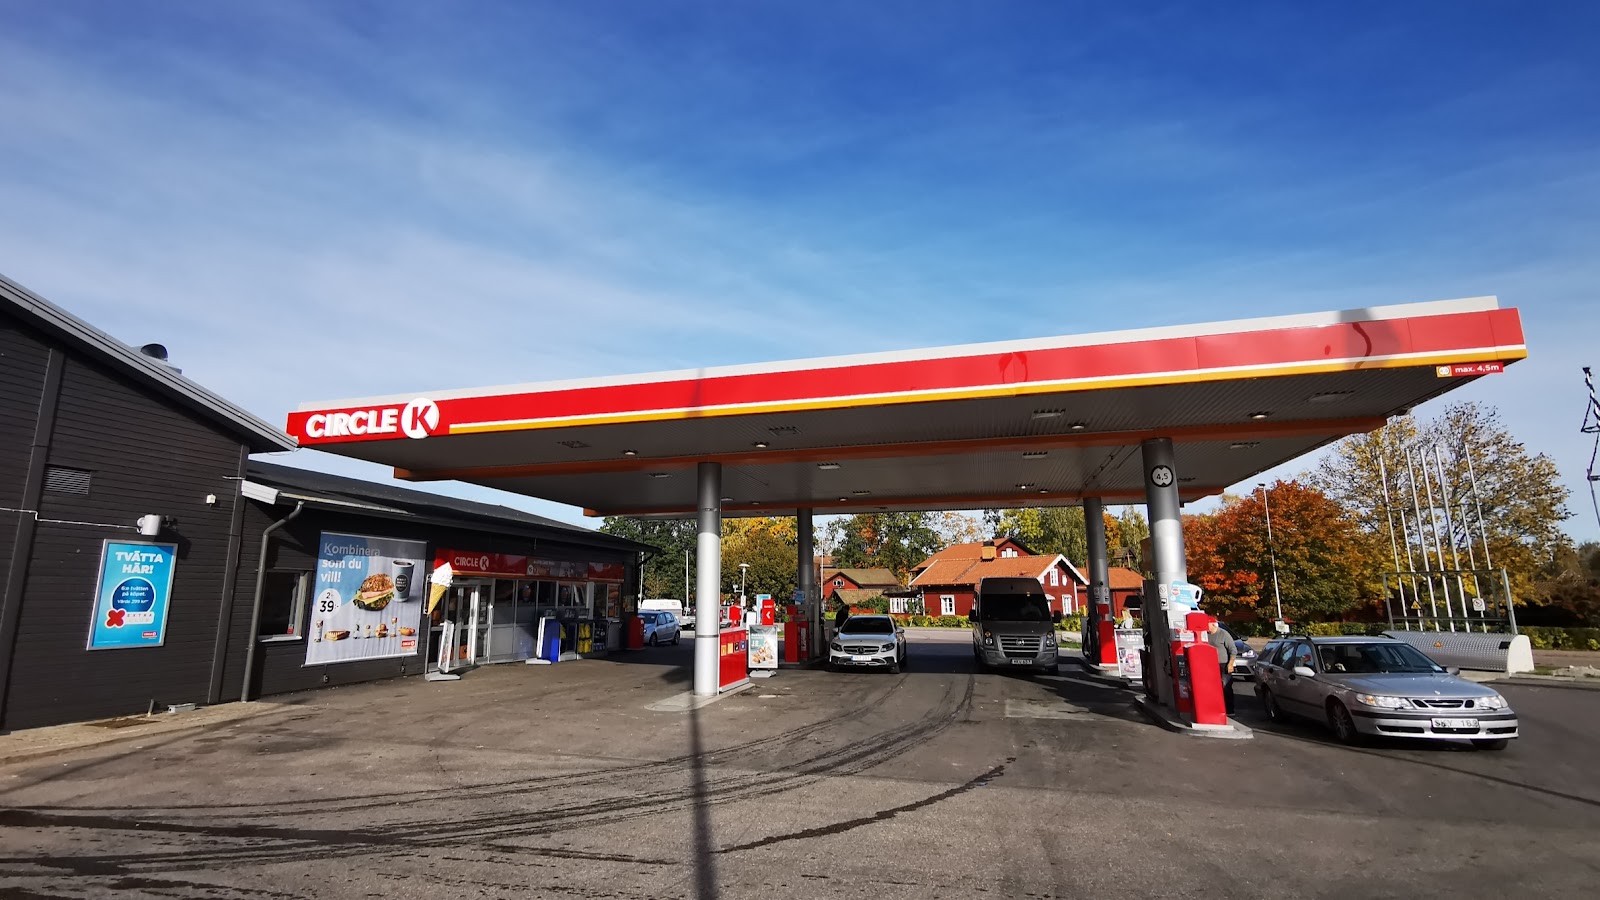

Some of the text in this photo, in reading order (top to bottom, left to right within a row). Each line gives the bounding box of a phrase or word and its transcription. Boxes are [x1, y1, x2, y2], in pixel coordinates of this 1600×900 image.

[305, 402, 436, 438] CIRCLE K
[323, 542, 381, 557] Kombinera
[115, 550, 164, 563] TVÄTTA
[454, 555, 489, 570] CIRCLE K
[122, 562, 154, 575] HÄR!
[321, 558, 362, 570] som du
[320, 571, 342, 583] vill!
